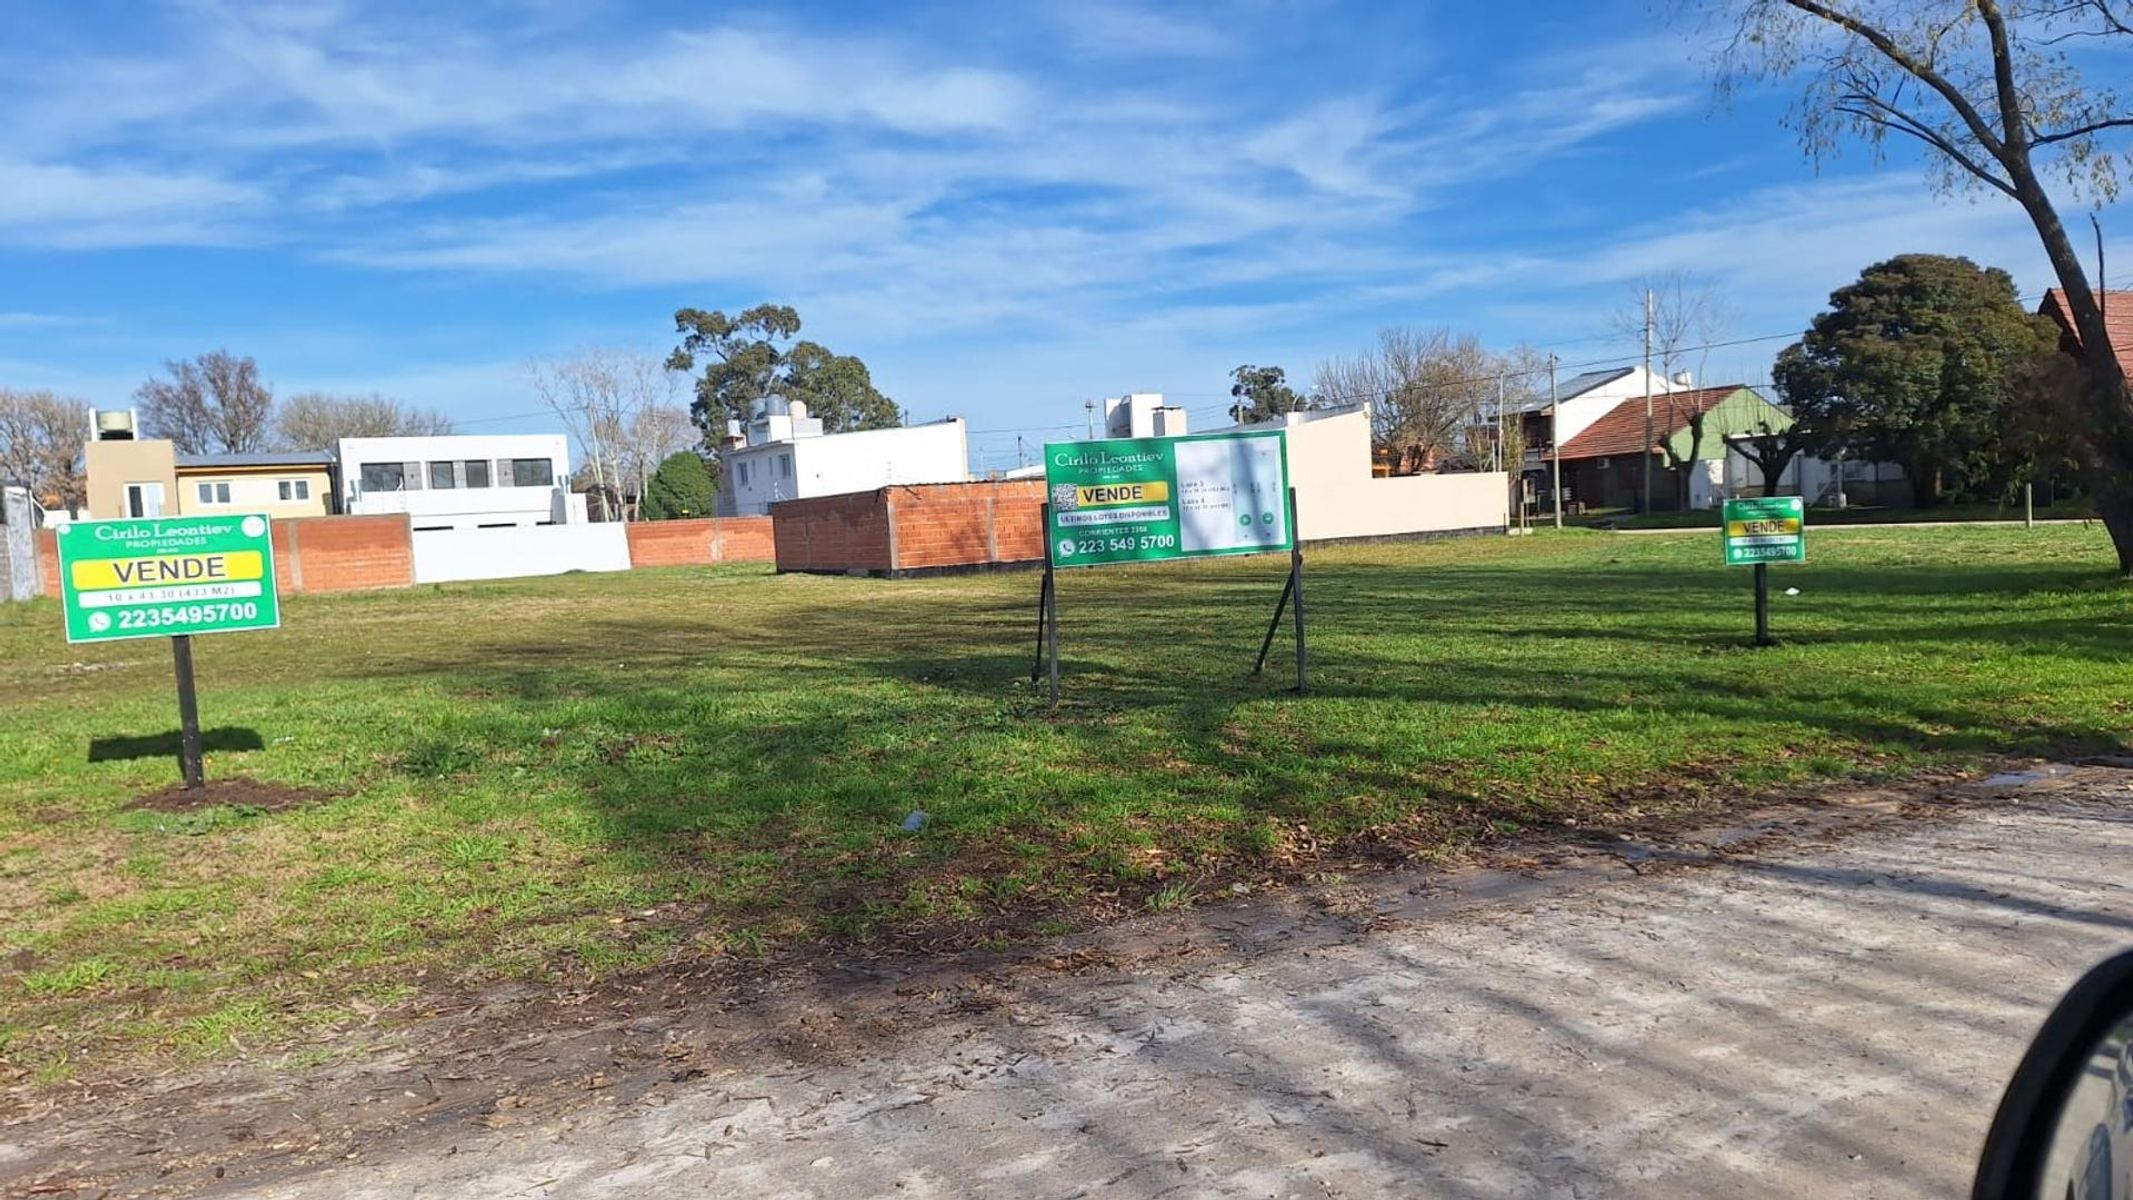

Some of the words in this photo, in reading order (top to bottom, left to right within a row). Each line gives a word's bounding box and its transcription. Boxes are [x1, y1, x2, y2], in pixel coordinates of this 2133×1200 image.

[1054, 453, 1098, 467] Cirilo
[1100, 451, 1164, 465] Leontiev
[1083, 485, 1144, 503] VENDE
[95, 525, 151, 541] Cirilo
[153, 523, 233, 539] Leontiev
[1743, 520, 1785, 533] VENDE
[125, 537, 207, 548] PROPIEDADES
[1079, 540, 1105, 554] 223
[1109, 537, 1135, 551] 549
[1140, 534, 1175, 549] 5700
[113, 556, 226, 583] VENDE
[118, 603, 258, 629] 2235495700
